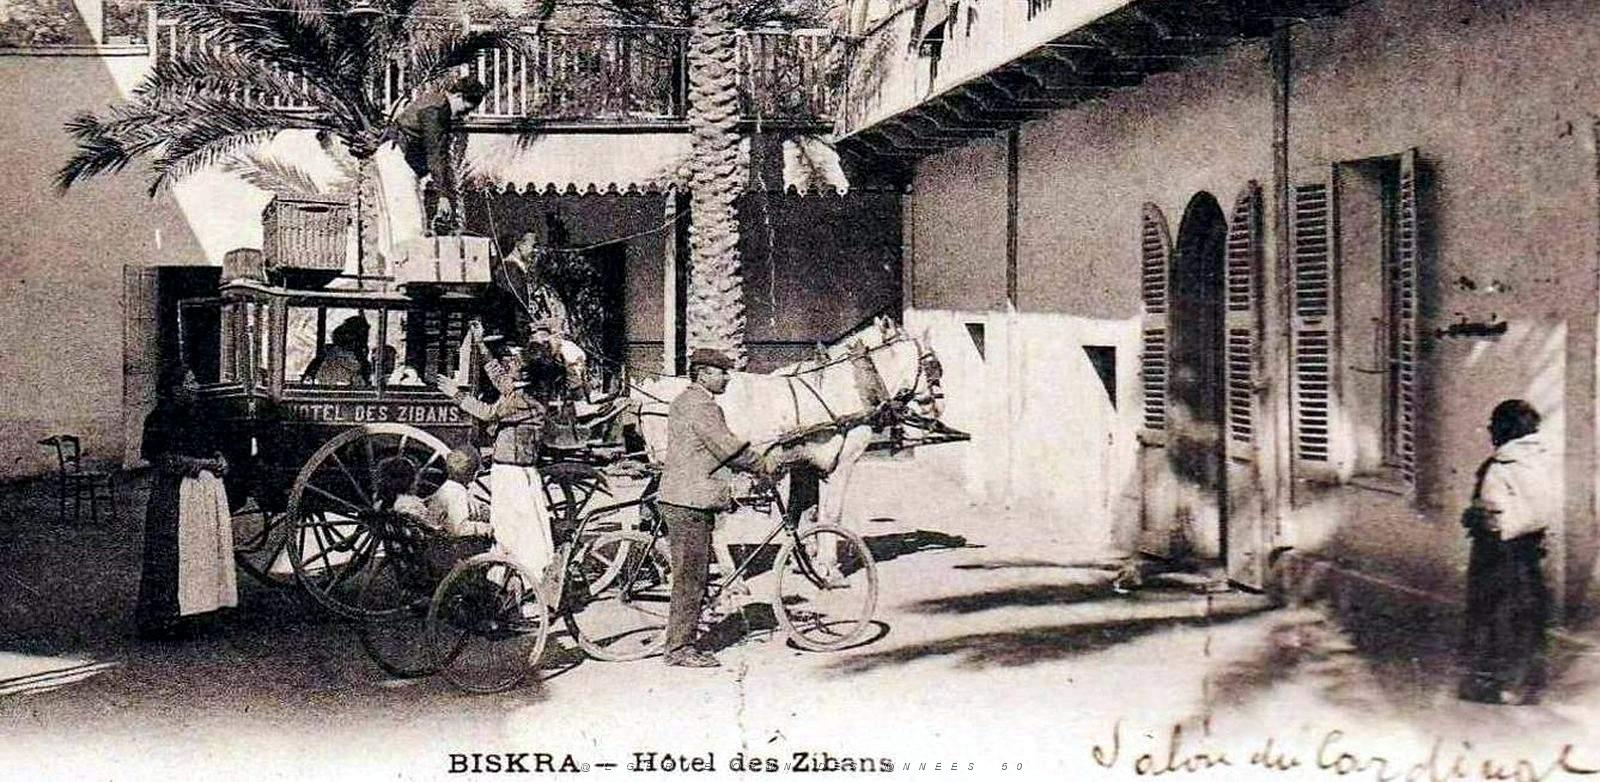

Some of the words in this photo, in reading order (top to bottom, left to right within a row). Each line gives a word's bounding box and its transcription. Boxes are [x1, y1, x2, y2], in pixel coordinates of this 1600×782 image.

[355, 405, 388, 422] DES
[398, 405, 459, 422] ZIBANS
[1250, 736, 1301, 771] du
